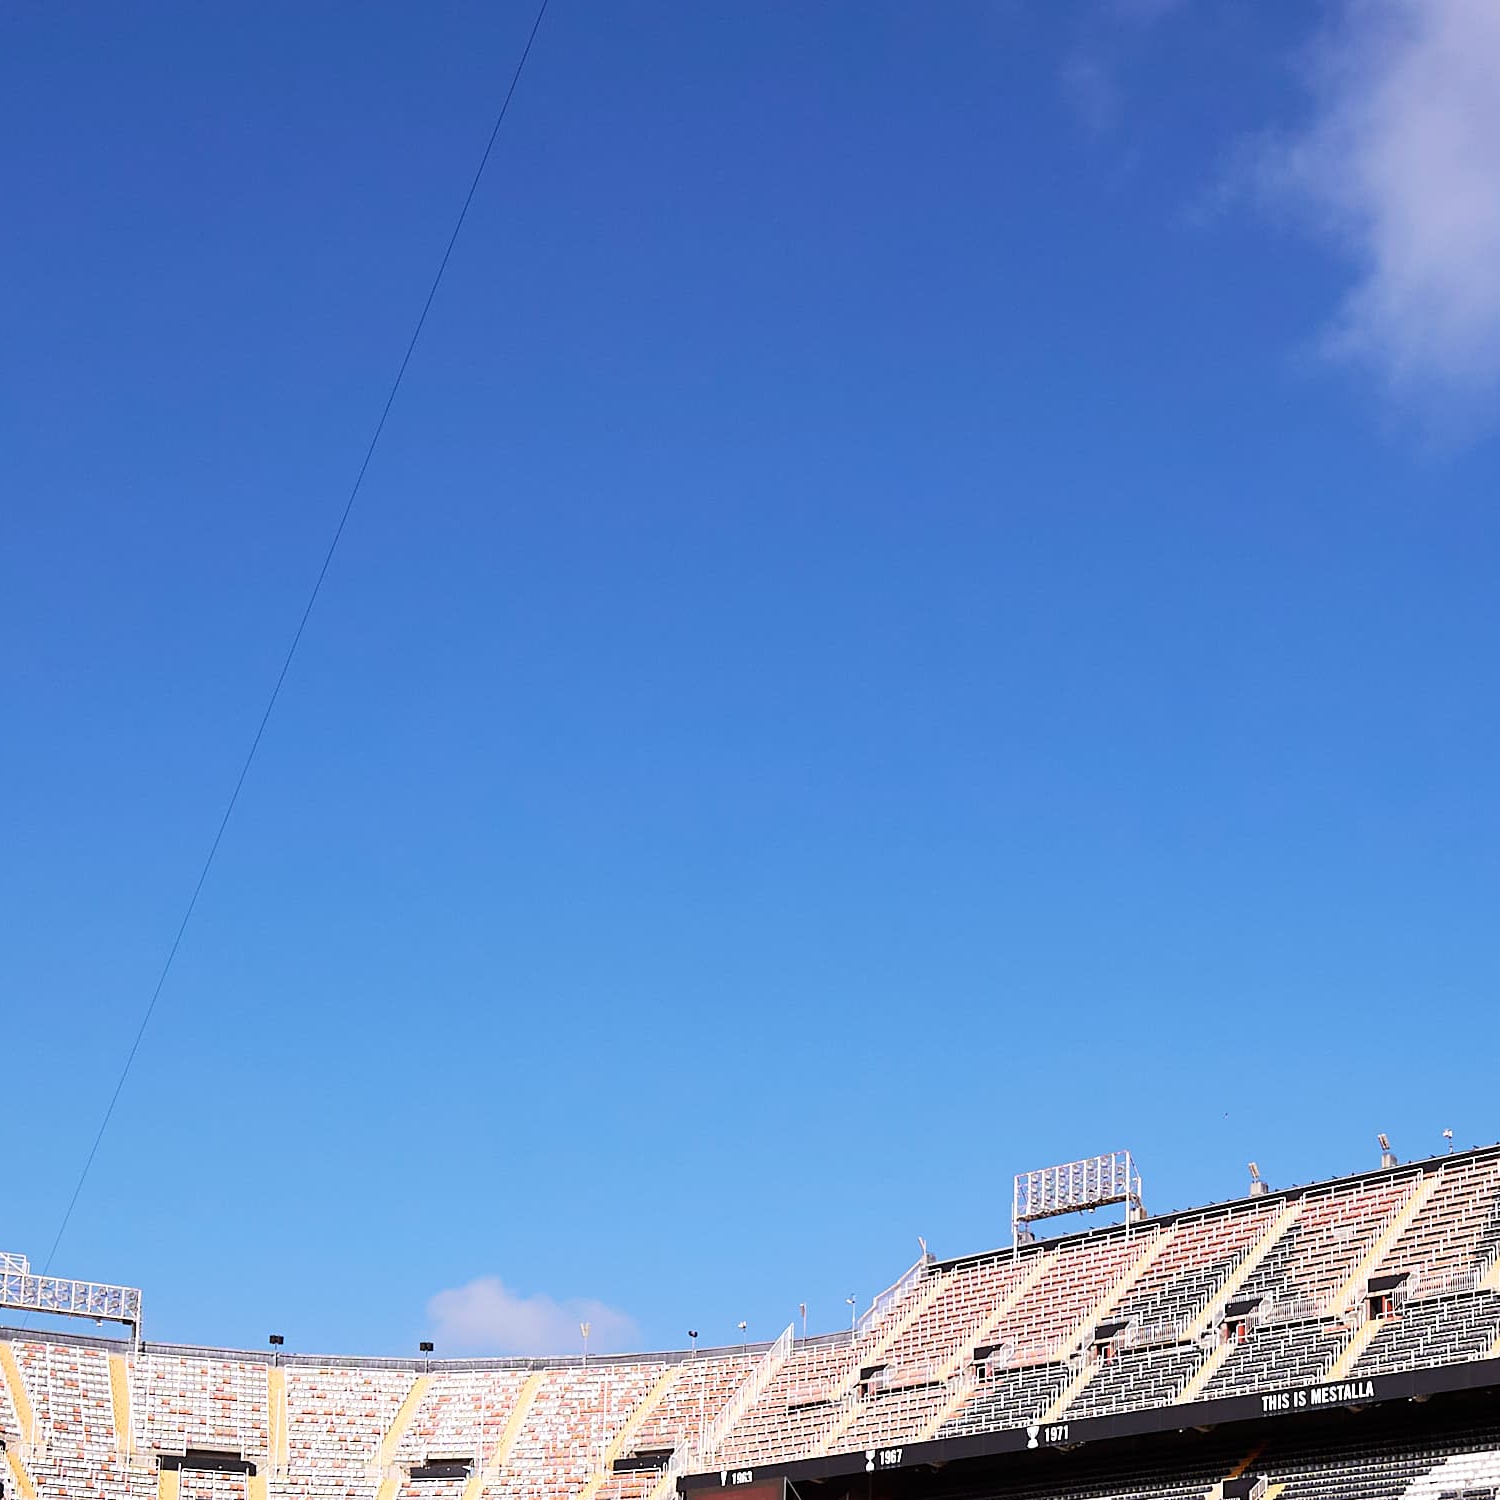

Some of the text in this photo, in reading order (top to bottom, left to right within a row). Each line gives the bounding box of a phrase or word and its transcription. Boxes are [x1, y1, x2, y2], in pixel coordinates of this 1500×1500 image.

[1262, 1381, 1375, 1412] THIS IS MESTALLA
[1044, 1425, 1069, 1442] 1971
[879, 1449, 903, 1466] 1967
[731, 1470, 753, 1484] 1963
